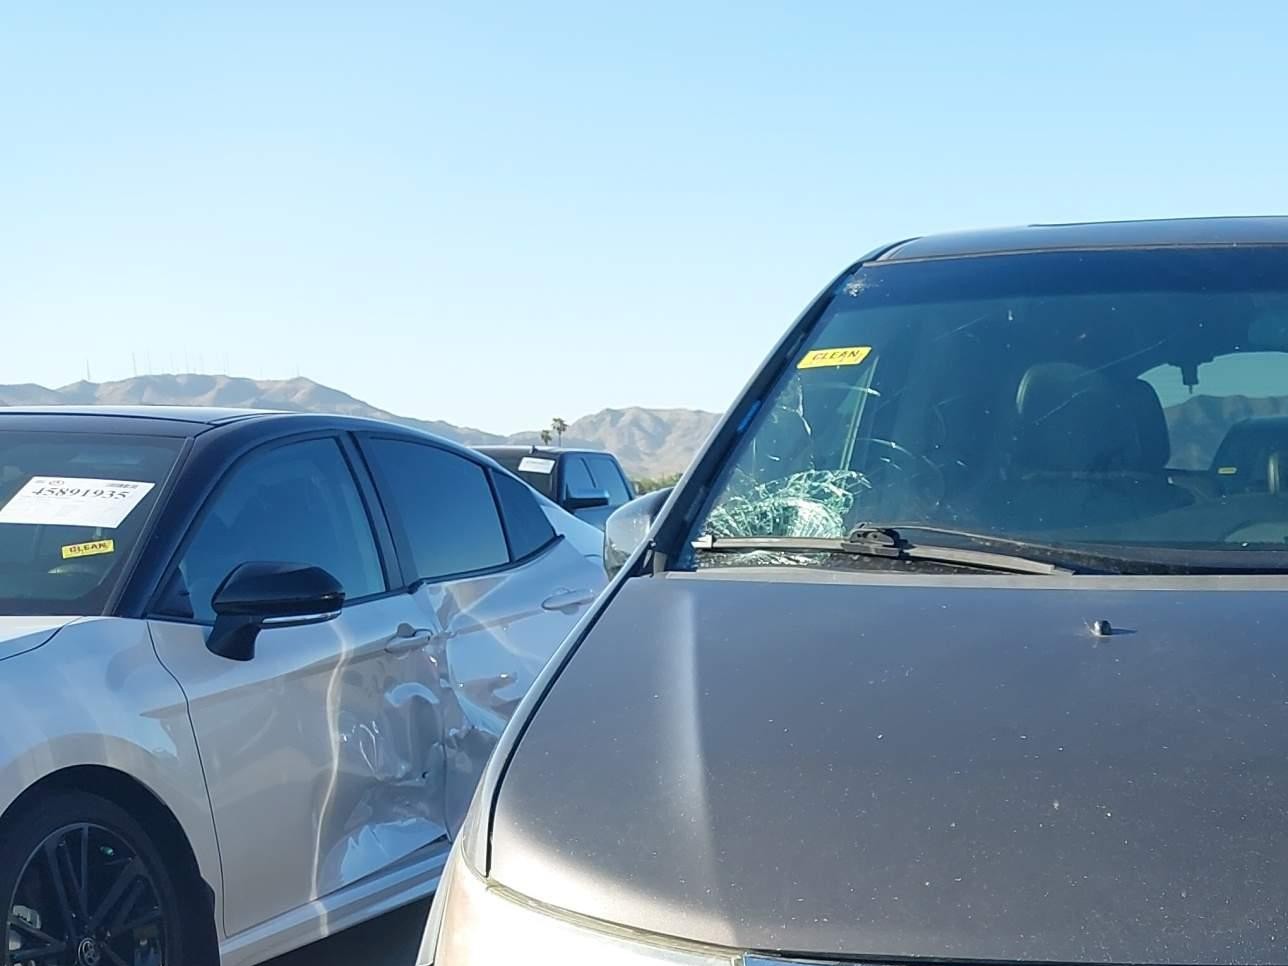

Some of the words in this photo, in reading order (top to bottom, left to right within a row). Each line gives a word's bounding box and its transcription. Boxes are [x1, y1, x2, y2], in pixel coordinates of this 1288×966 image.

[812, 349, 861, 361] CLEAN
[32, 486, 130, 500] 45891935
[68, 542, 107, 553] CLEAN
